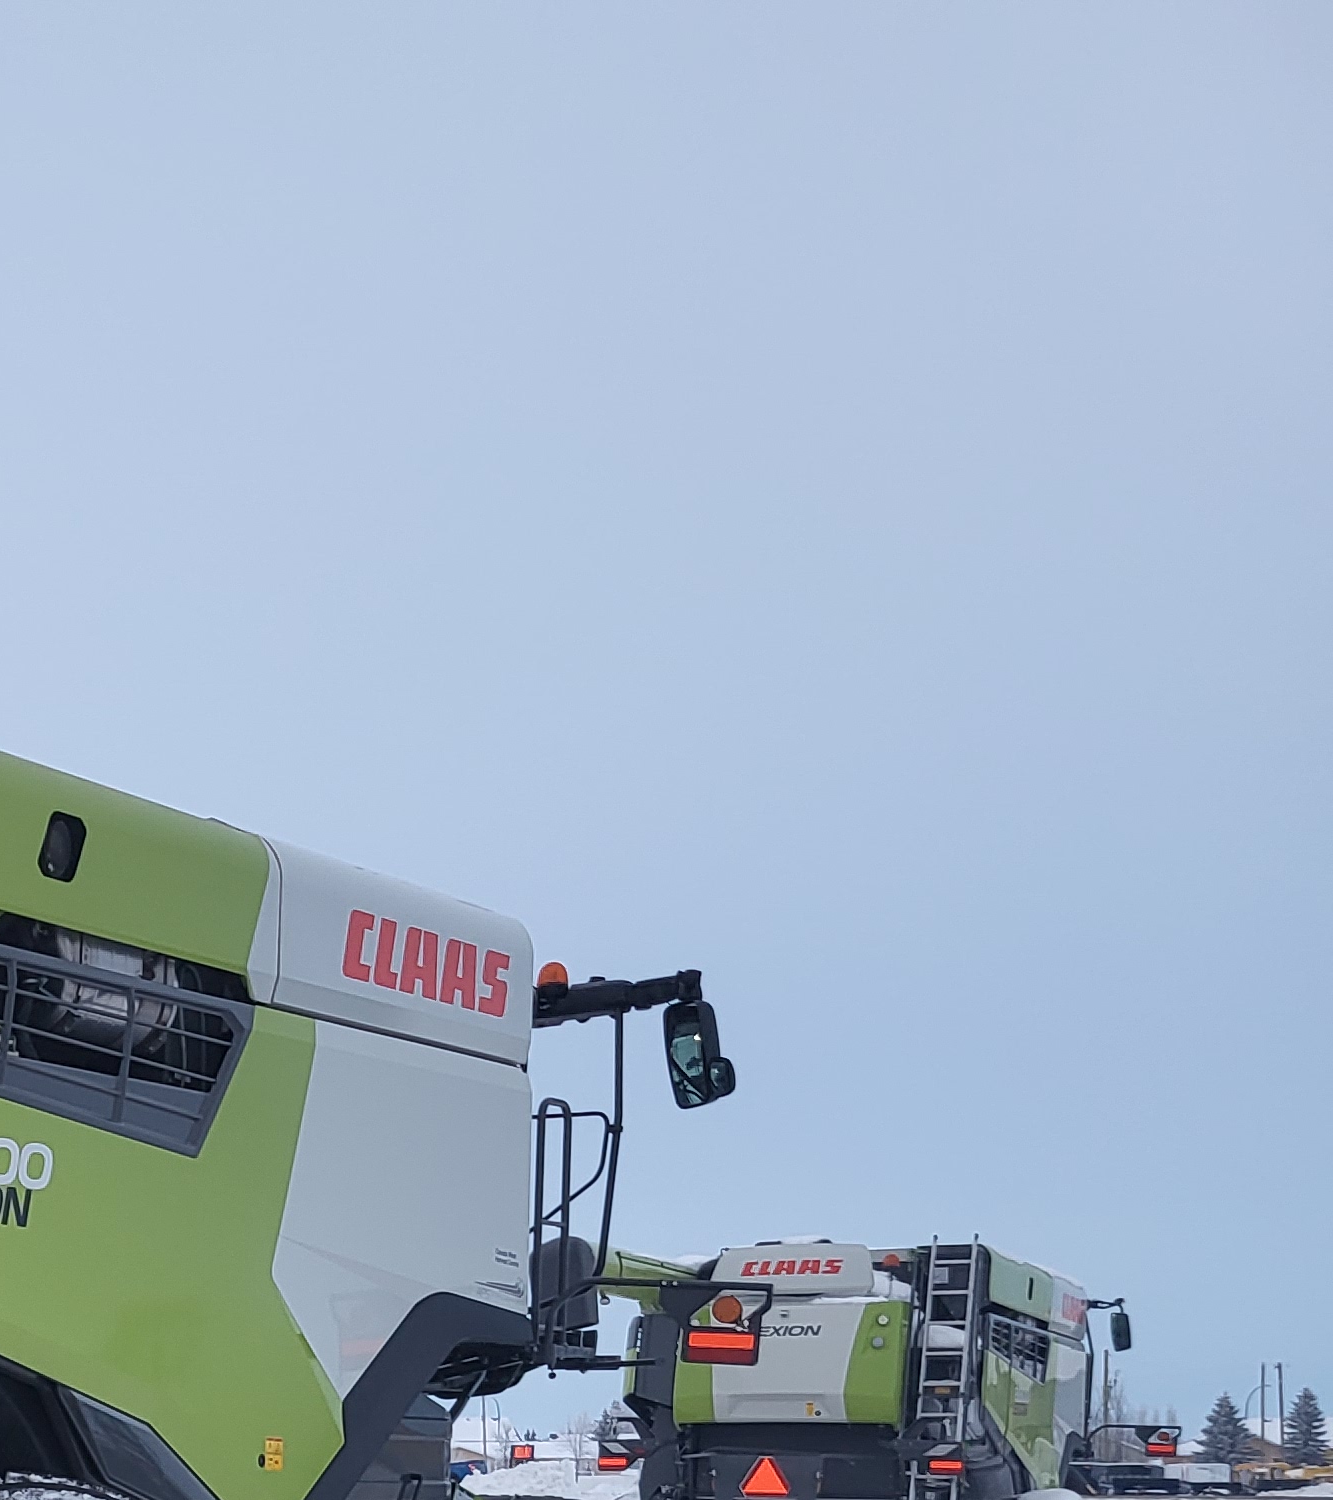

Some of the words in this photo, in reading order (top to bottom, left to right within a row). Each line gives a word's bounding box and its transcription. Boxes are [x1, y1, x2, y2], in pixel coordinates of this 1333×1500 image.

[342, 909, 510, 1018] CLAAS
[741, 1259, 843, 1277] CLAAS
[760, 1324, 822, 1337] EXION
